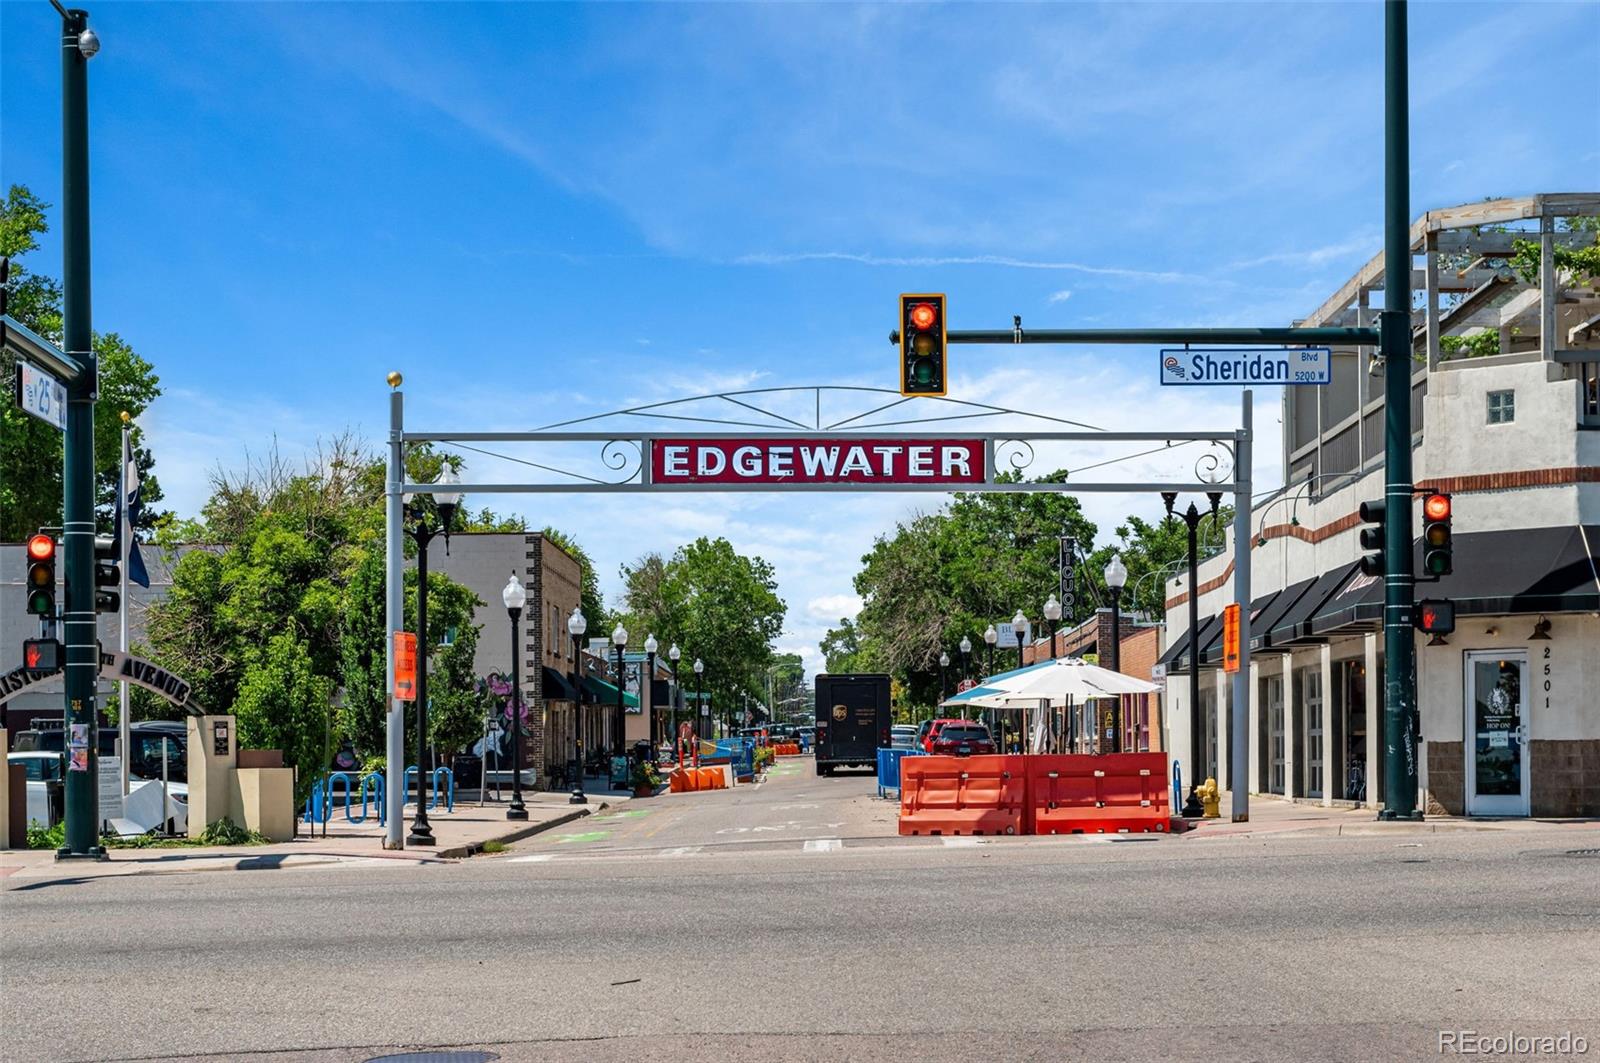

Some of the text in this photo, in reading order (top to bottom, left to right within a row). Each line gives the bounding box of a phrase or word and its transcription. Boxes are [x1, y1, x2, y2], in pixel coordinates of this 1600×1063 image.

[1191, 354, 1289, 380] Sheridan
[1301, 352, 1318, 361] Blvd
[1295, 371, 1325, 381] 5200 W
[38, 377, 51, 415] 25
[663, 446, 970, 476] EDGEWATER
[1062, 540, 1075, 619] LIQUOR
[121, 658, 190, 700] AVENUE
[1543, 646, 1551, 708] 2501
